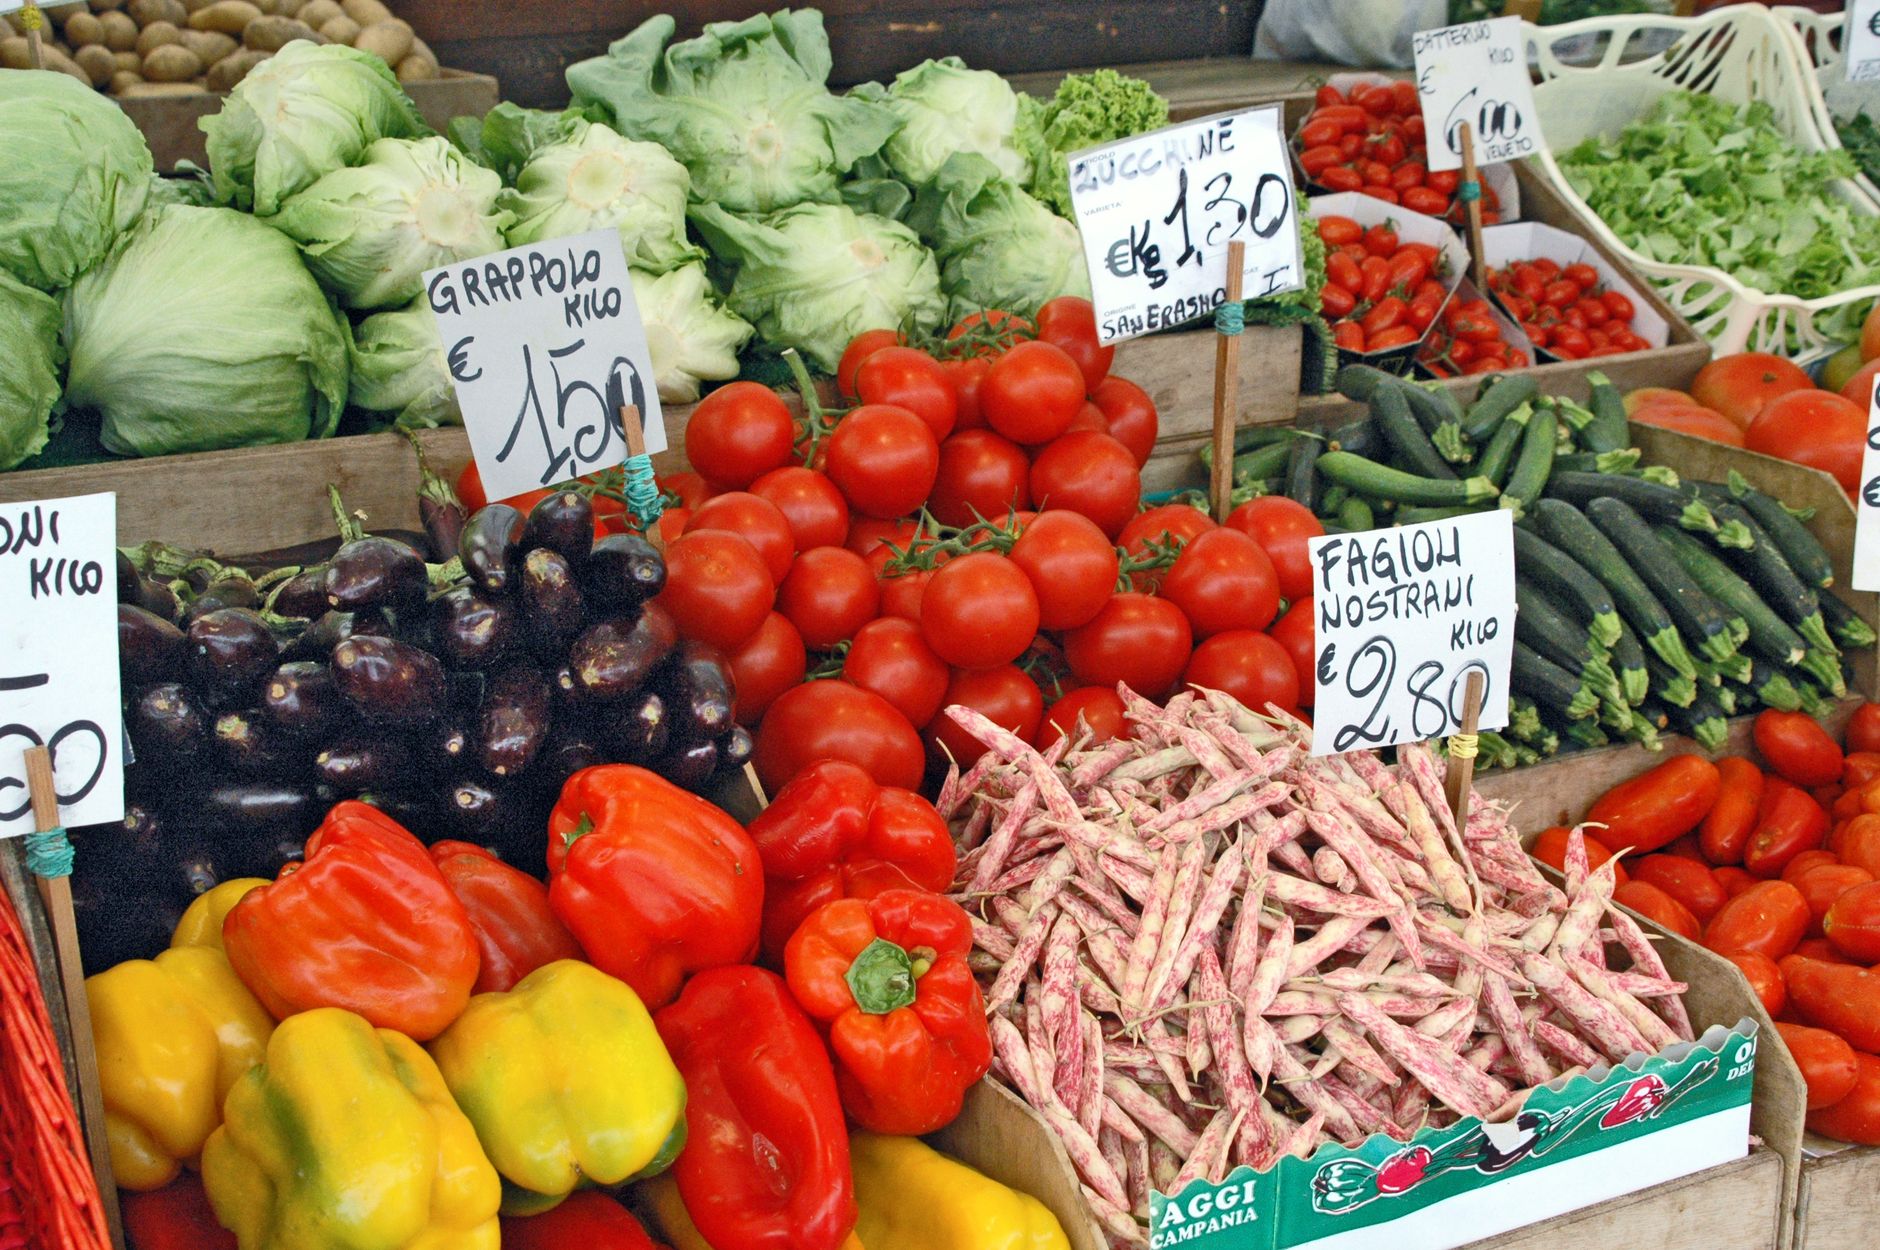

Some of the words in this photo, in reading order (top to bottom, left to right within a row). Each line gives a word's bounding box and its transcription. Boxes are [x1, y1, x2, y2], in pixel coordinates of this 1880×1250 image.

[1419, 65, 1437, 95] €
[1073, 118, 1235, 194] ZUCCHINE
[1164, 167, 1289, 267] 1,30
[427, 248, 601, 315] GRAPPOLO
[563, 287, 622, 329] KILO
[447, 336, 483, 383] €
[495, 338, 647, 485] 1,50
[30, 557, 103, 600] KILO
[1316, 526, 1462, 593] FAGIOLI
[1320, 573, 1474, 634] NOSTRANI
[1450, 616, 1499, 652] KILO
[1316, 642, 1338, 686] €
[1333, 634, 1491, 753] 2,80
[1149, 1179, 1257, 1229] AGGI
[1150, 1206, 1259, 1250] CAMPANIA
